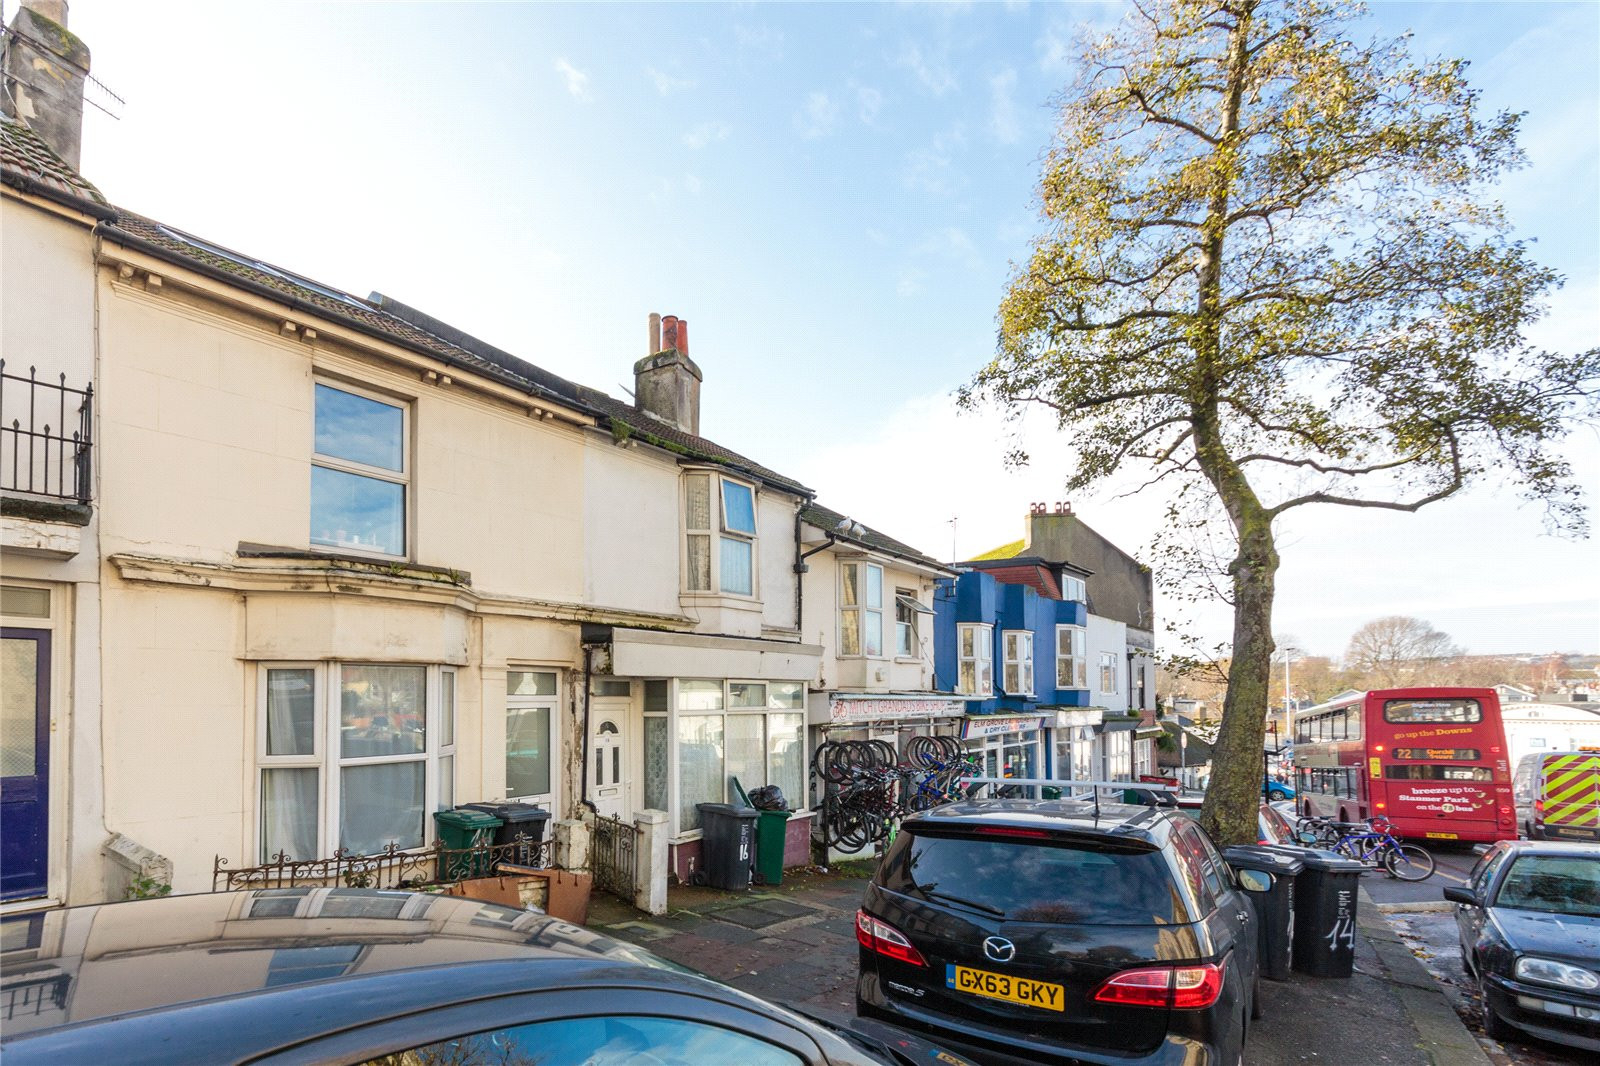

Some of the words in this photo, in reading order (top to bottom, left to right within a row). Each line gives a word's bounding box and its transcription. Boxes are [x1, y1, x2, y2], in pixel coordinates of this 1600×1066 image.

[1436, 728, 1473, 736] Downs
[1397, 749, 1412, 759] 22
[739, 843, 749, 861] 16
[1324, 918, 1355, 951] 14
[960, 969, 1011, 996] GX63
[1017, 980, 1059, 1006] GKY
